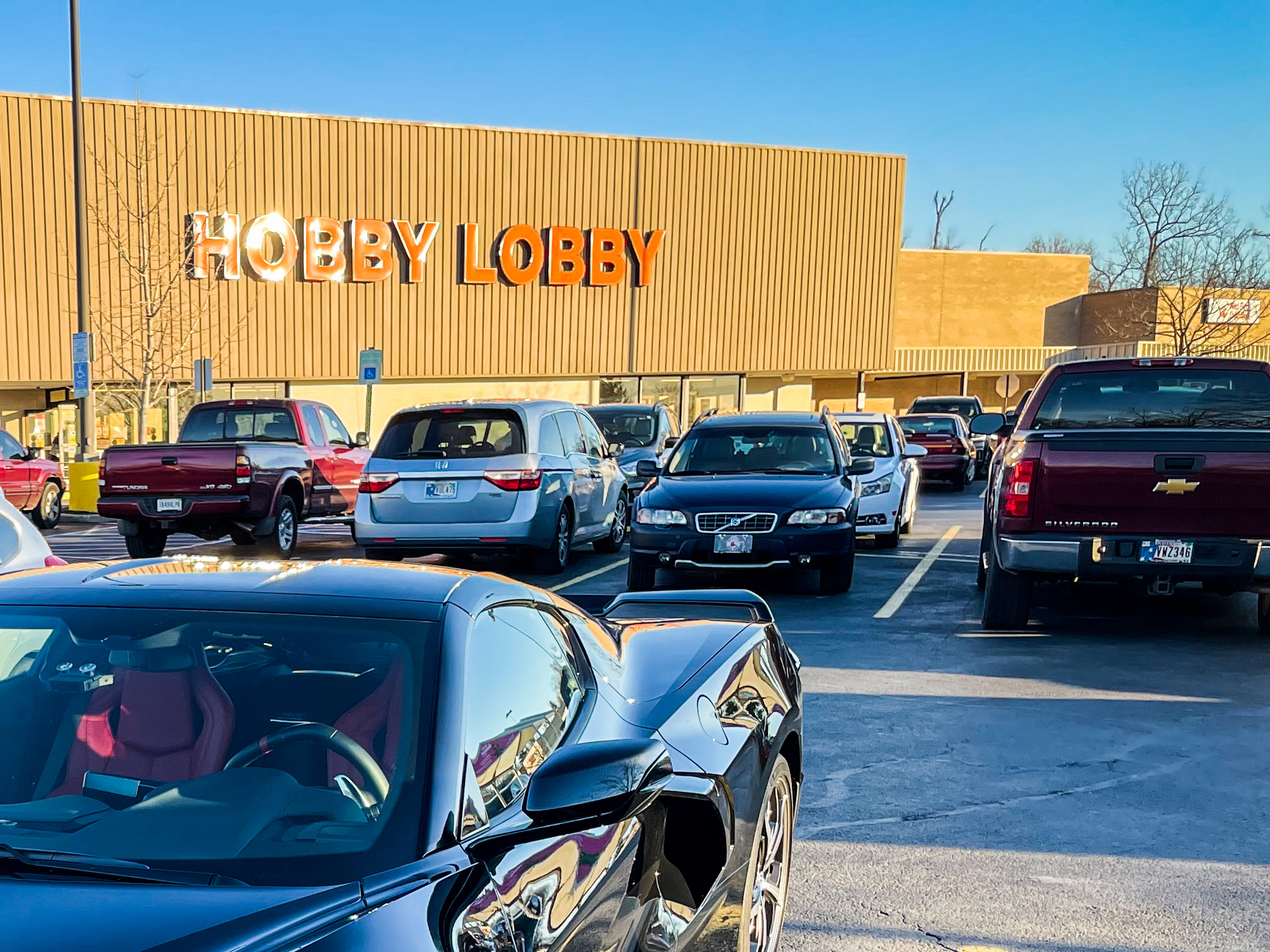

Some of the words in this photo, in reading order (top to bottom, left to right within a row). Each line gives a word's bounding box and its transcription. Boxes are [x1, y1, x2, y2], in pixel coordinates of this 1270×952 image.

[190, 211, 440, 283] HOBBY
[461, 222, 666, 287] LOBBY
[1044, 520, 1119, 528] SILVERADO
